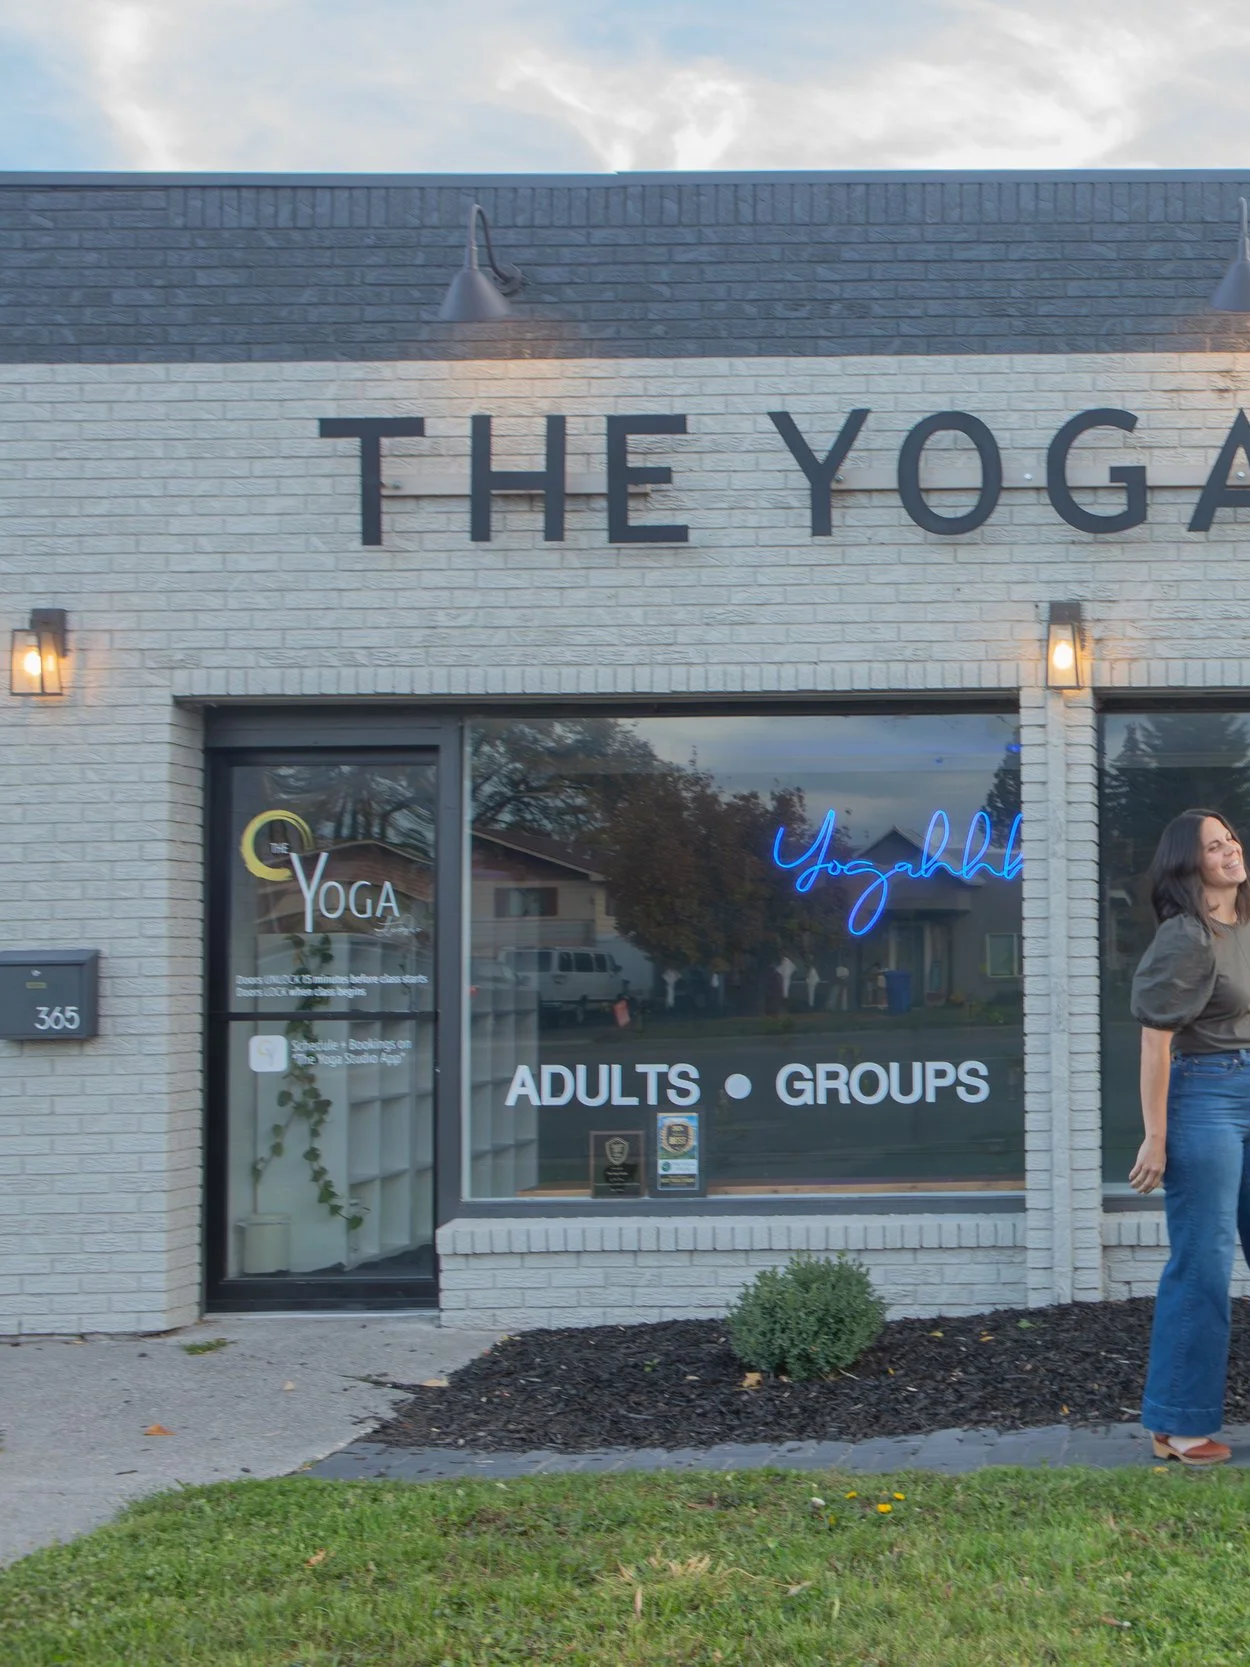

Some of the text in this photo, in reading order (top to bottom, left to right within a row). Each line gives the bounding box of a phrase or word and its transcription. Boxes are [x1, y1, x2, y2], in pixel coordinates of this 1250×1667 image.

[318, 413, 690, 546] THE
[269, 842, 290, 854] THE
[289, 852, 400, 933] YOGA
[235, 973, 429, 985] Doors UNLOCK 15 minutes before class starts
[235, 987, 367, 999] Doors LOCK when class begins
[33, 1006, 81, 1030] 365
[291, 1039, 338, 1051] Schedule
[349, 1038, 396, 1052] Bookings
[396, 1040, 413, 1050] on
[318, 1053, 344, 1067] Yoga
[344, 1052, 379, 1065] Studio
[504, 1060, 990, 1107] ADULTS GROUPS
